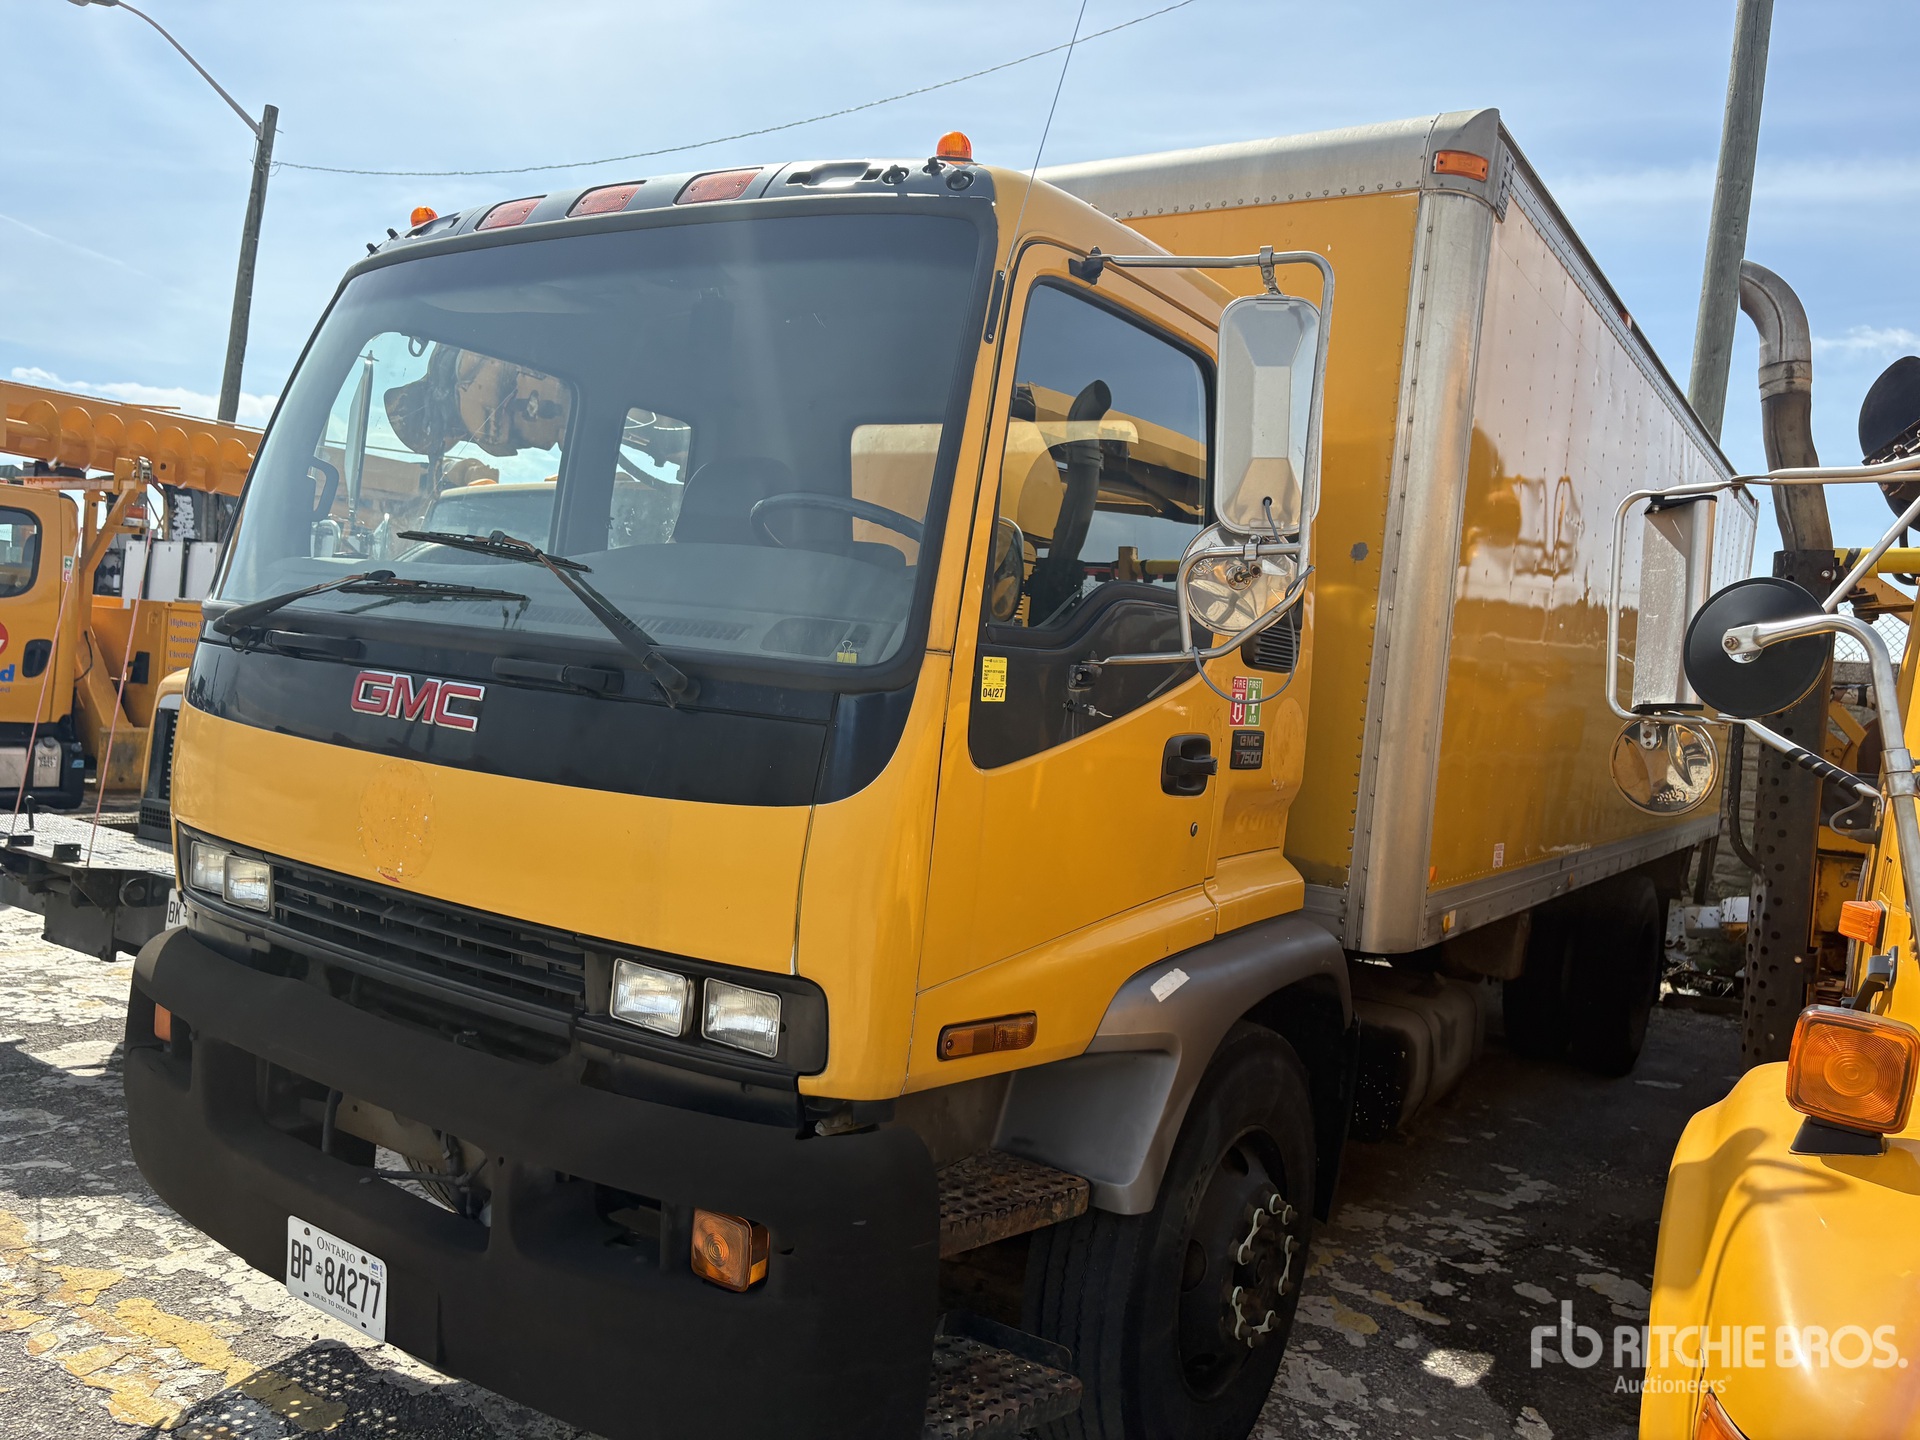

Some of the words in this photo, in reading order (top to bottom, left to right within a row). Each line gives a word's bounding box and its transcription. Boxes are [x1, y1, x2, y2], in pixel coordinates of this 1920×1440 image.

[983, 688, 1004, 698] 04/27
[1233, 679, 1246, 689] FIRE
[1248, 680, 1262, 689] FIRST
[351, 669, 485, 732] GMC
[1248, 715, 1257, 723] AID
[1240, 735, 1260, 747] GMC
[168, 901, 182, 925] BK
[316, 1236, 356, 1264] ONTARIO
[290, 1238, 313, 1282] BP
[324, 1256, 381, 1320] 84277
[312, 1290, 327, 1303] YOURS
[328, 1298, 335, 1307] TO
[335, 1302, 359, 1320] DISCOVER
